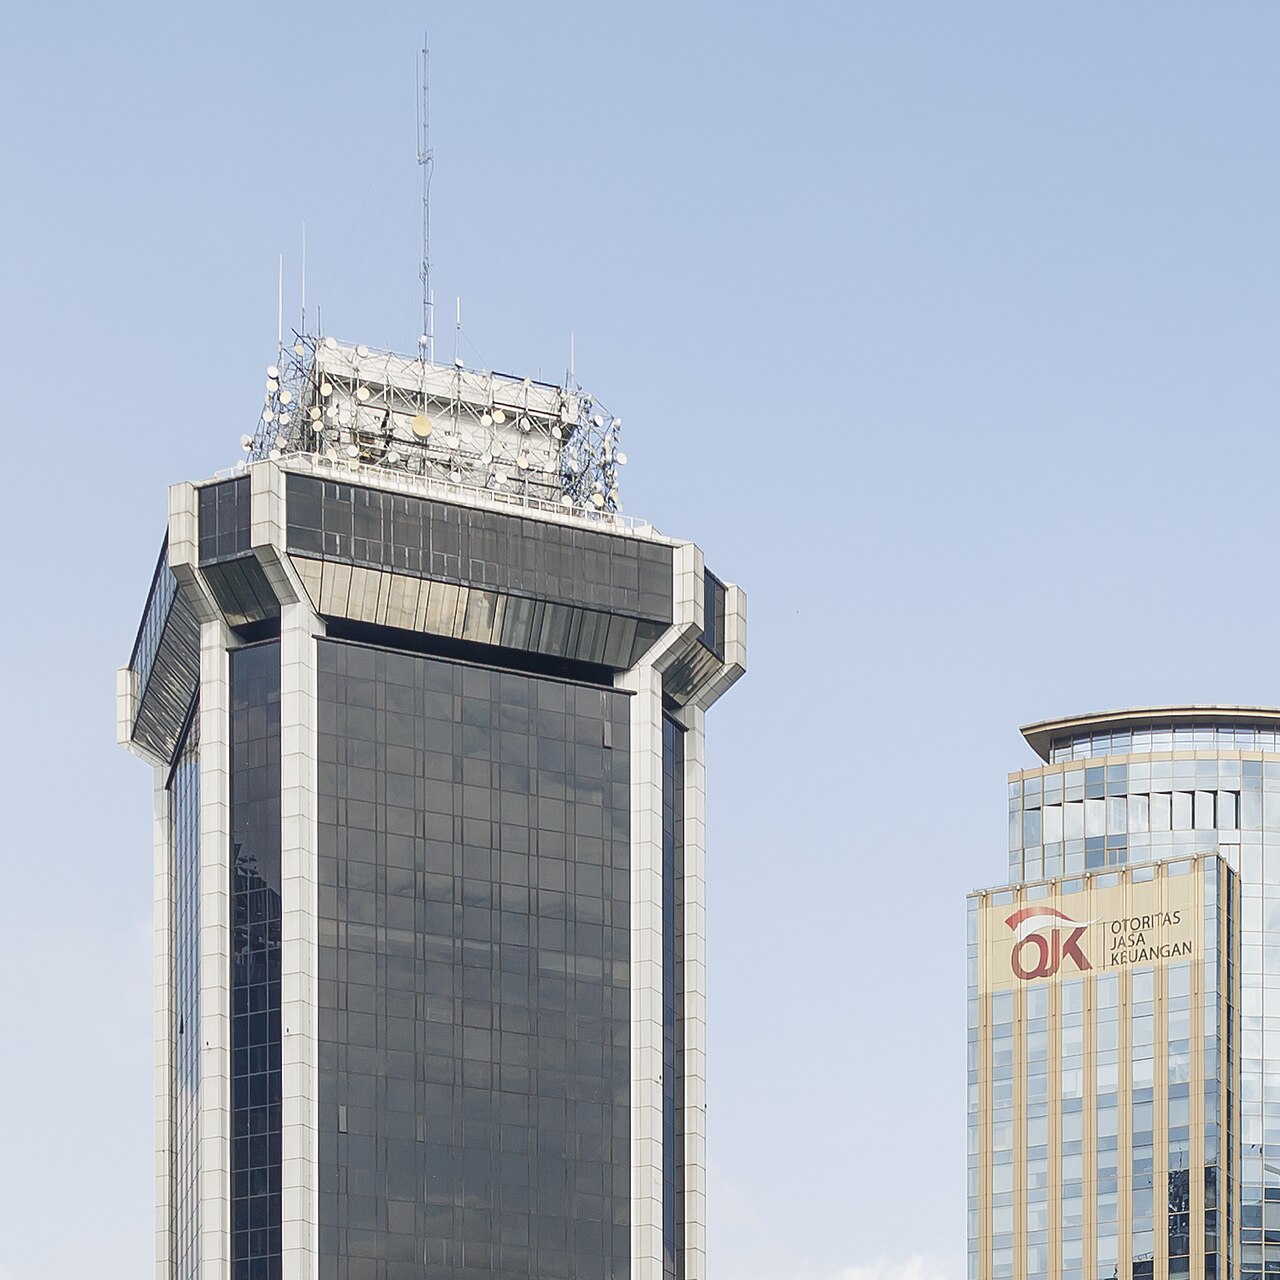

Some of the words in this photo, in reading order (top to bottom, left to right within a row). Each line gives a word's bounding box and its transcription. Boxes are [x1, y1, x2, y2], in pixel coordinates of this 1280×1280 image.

[1110, 910, 1182, 935] OTORITAS
[1110, 932, 1146, 951] JASA
[1110, 941, 1193, 967] KEUANGAN
